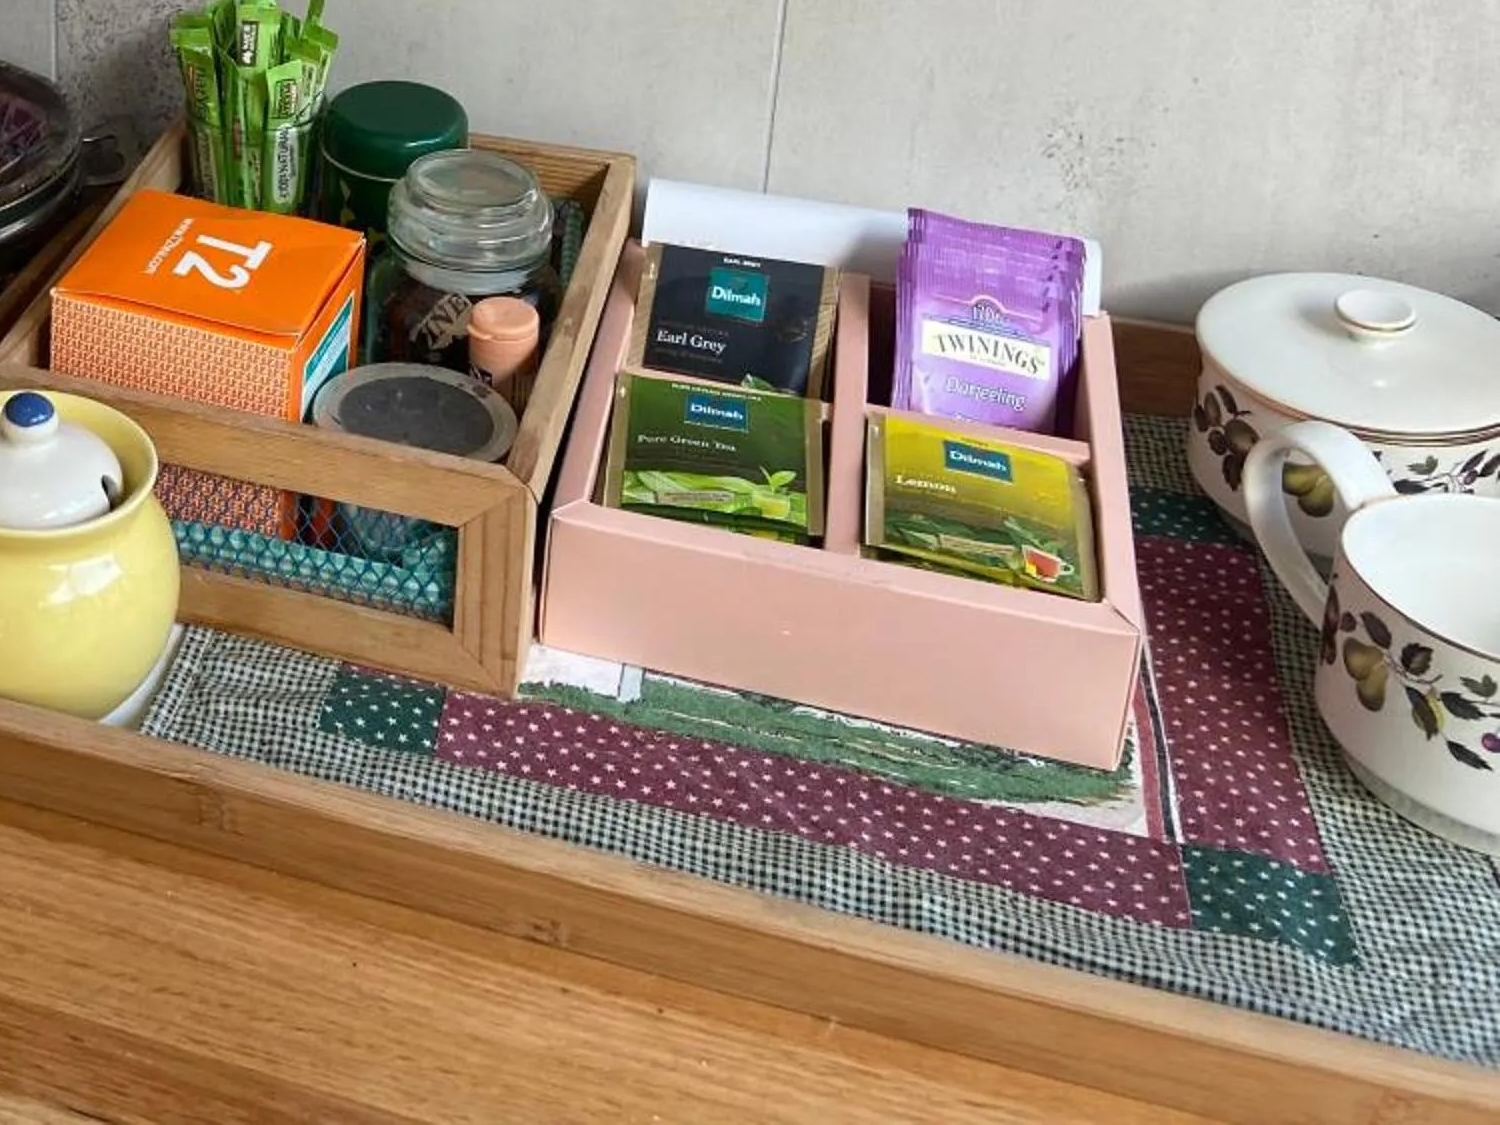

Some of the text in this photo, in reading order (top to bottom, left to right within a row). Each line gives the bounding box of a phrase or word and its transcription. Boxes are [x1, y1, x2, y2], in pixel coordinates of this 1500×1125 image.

[172, 234, 273, 289] T2
[711, 285, 762, 307] Dilmah
[656, 328, 687, 346] Earl
[689, 334, 727, 355] Grey
[932, 333, 1039, 375] TWININGS
[946, 376, 1027, 412] Darjeeling
[689, 403, 744, 420] Dilmah
[637, 433, 737, 452] Pure Green Tea
[949, 449, 1008, 472] Dilmah
[895, 474, 957, 494] Lemon
